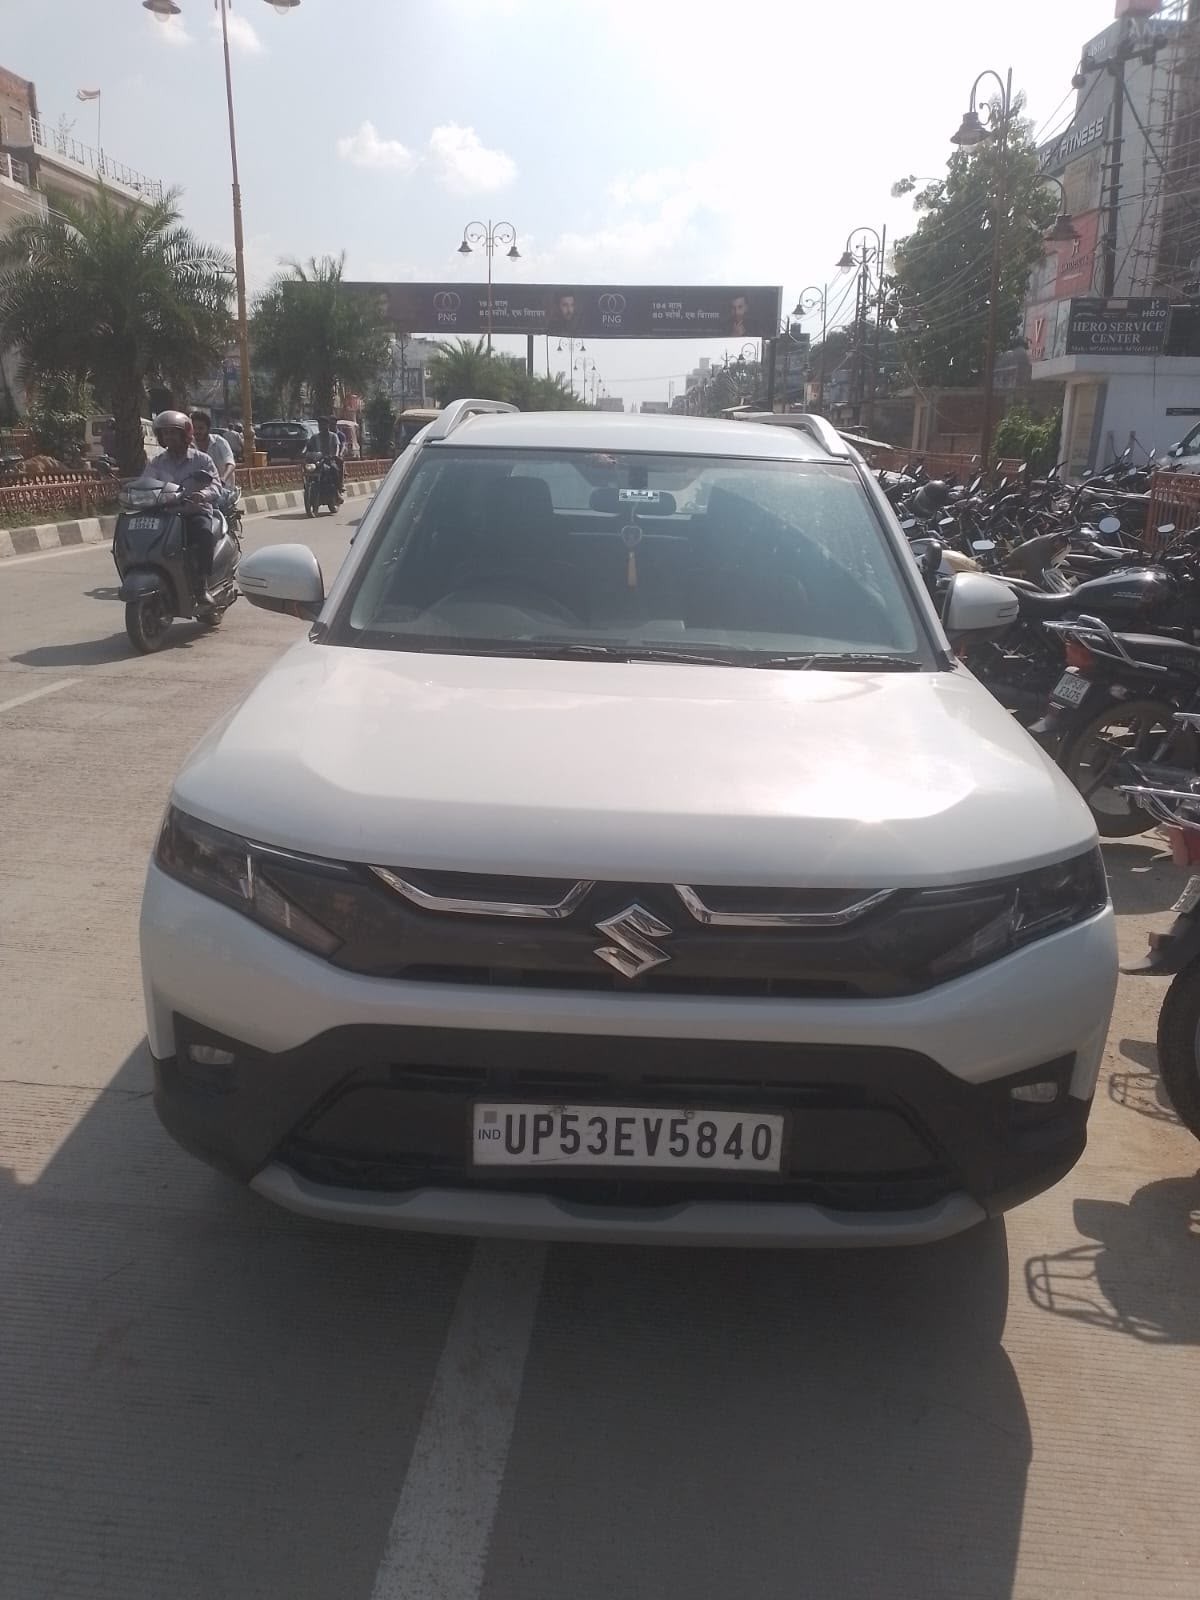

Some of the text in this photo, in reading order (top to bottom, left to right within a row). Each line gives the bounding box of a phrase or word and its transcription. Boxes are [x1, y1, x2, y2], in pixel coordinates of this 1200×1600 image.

[1060, 118, 1104, 160] FITNESS
[438, 312, 457, 321] PNG
[602, 314, 622, 324] PNG
[1072, 320, 1164, 332] HERO SERVICE
[1091, 332, 1141, 344] CENTER
[478, 1128, 501, 1140] IND
[505, 1113, 772, 1161] UP53EV5840
